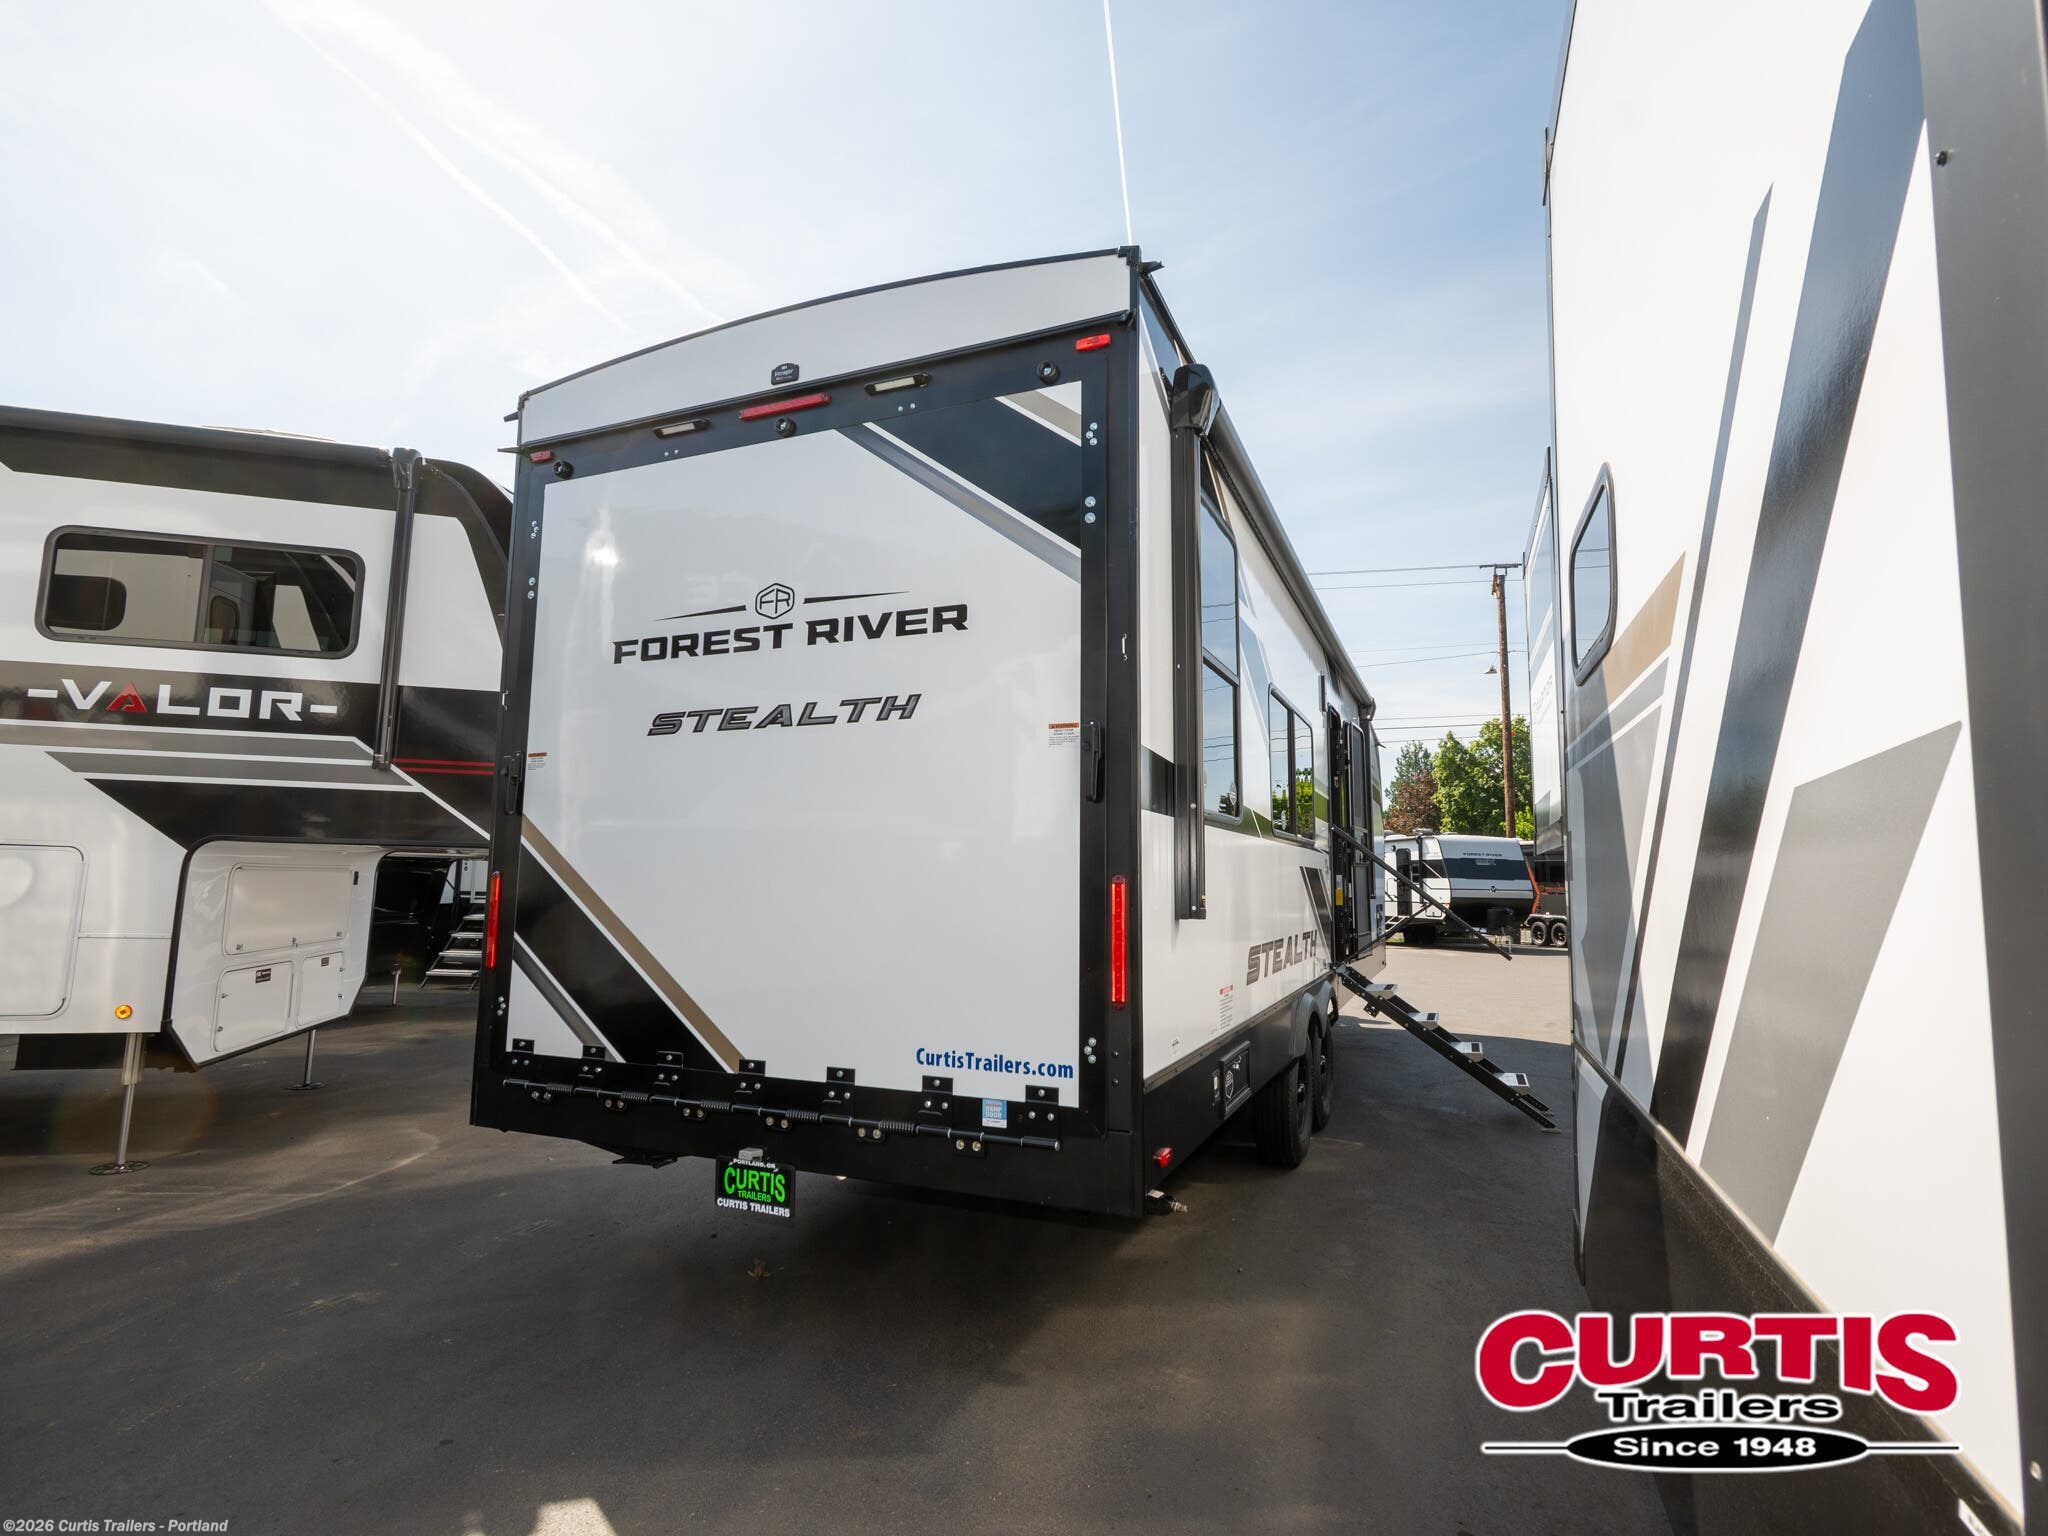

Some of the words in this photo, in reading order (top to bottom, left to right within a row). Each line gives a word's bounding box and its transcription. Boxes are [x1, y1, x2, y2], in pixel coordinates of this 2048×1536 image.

[613, 623, 793, 664] FOREST
[805, 604, 968, 645] RIVER
[647, 693, 922, 736] STEALTH
[1246, 929, 1318, 986] STEALTH
[916, 1047, 1074, 1079] CurtisTrailers.com
[724, 1167, 785, 1203] CURTIS
[738, 1190, 772, 1203] TRAILERS
[717, 1197, 748, 1210] CURTIS
[750, 1201, 790, 1218] TRAILERS
